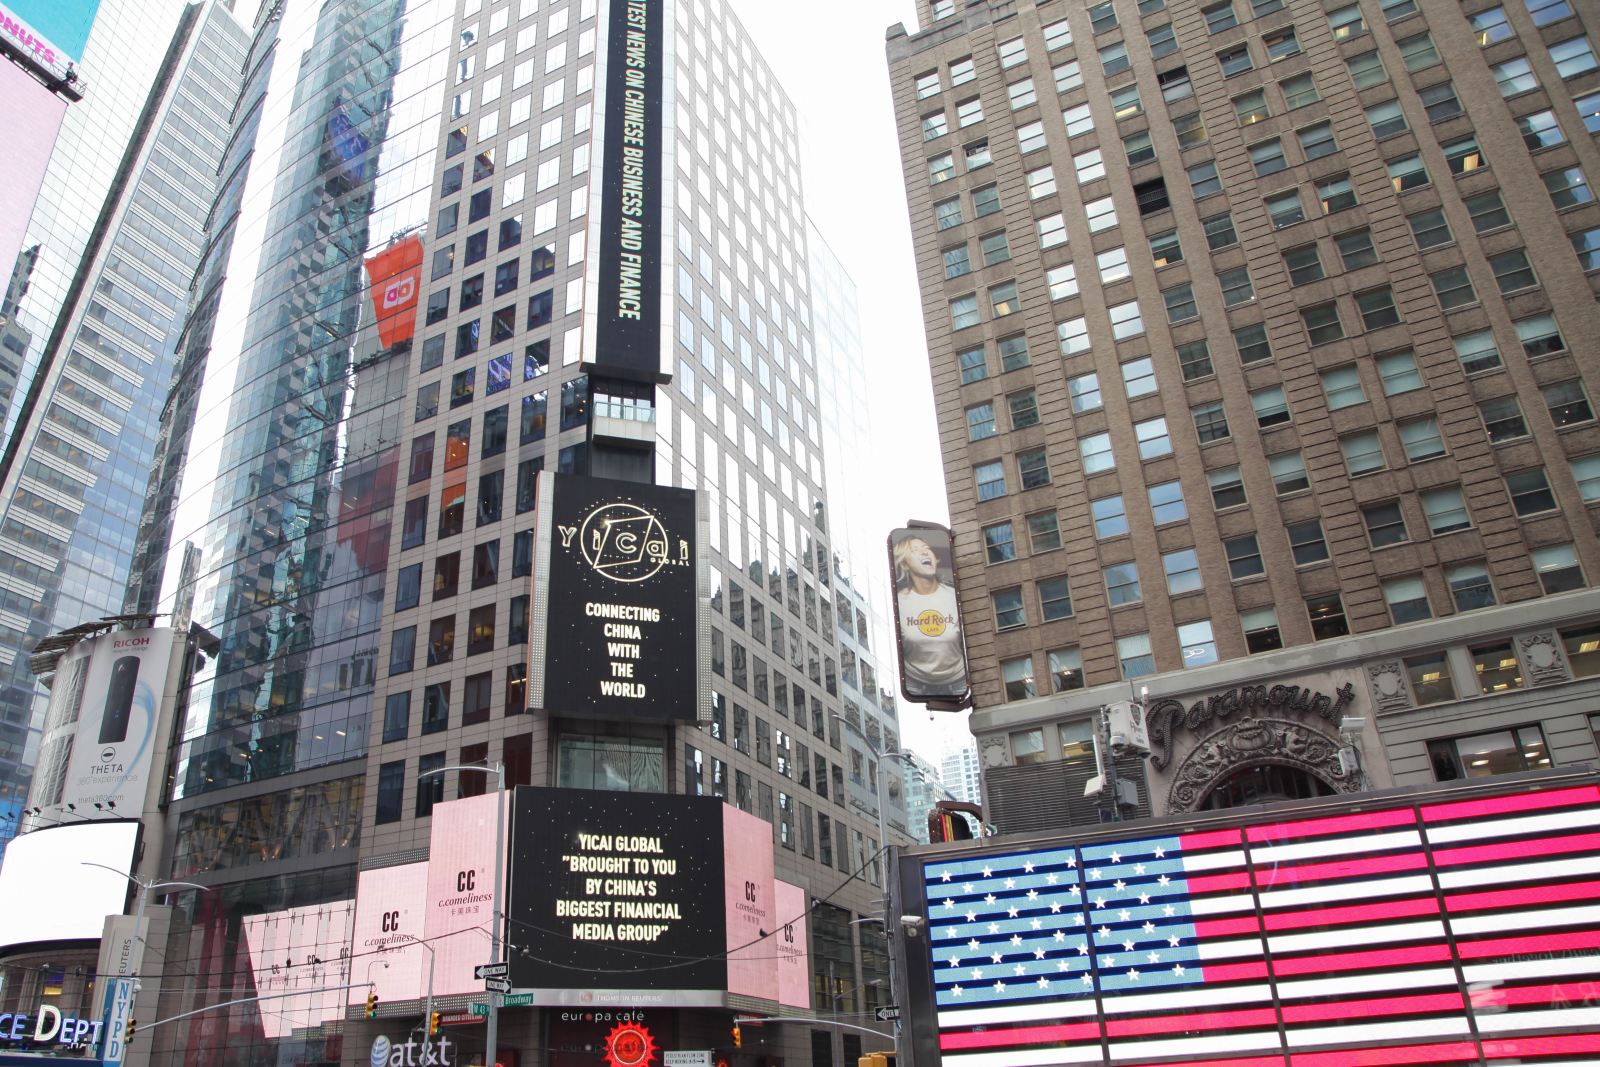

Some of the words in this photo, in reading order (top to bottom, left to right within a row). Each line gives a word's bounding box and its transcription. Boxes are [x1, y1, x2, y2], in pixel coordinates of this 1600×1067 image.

[625, 31, 645, 69] NEWS
[625, 69, 645, 89] ON
[623, 90, 645, 147] CHINESE
[621, 147, 644, 217] BUSINESS
[620, 217, 642, 250] AND
[618, 253, 642, 321] FINANCE
[585, 602, 660, 622] CONNECTING
[906, 614, 930, 626] Hard
[932, 614, 955, 626] Rock
[604, 623, 641, 640] CHINA
[113, 637, 150, 649] RICOH
[607, 642, 640, 659] WITH
[610, 662, 634, 678] THE
[600, 681, 646, 699] WORLD
[1147, 682, 1355, 775] Paramount
[90, 763, 123, 774] THETA
[578, 833, 613, 851] YICAI
[615, 836, 664, 853] GLOBAL
[633, 859, 650, 875] TO
[652, 859, 677, 875] YOU
[457, 870, 476, 892] CC
[585, 878, 603, 895] BY
[604, 879, 657, 897] CHINA'S
[438, 893, 493, 908] c.comeliness
[745, 881, 756, 903] CC
[556, 900, 612, 918] BIGGEST
[613, 902, 682, 919] FINANCIAL
[382, 911, 399, 932] CC
[572, 923, 615, 940] MEDIA
[784, 923, 794, 943] CC
[480, 1005, 486, 1015] 43
[505, 994, 532, 1006] Broadway
[109, 982, 130, 1059] NYPD
[389, 1035, 452, 1067] at&t
